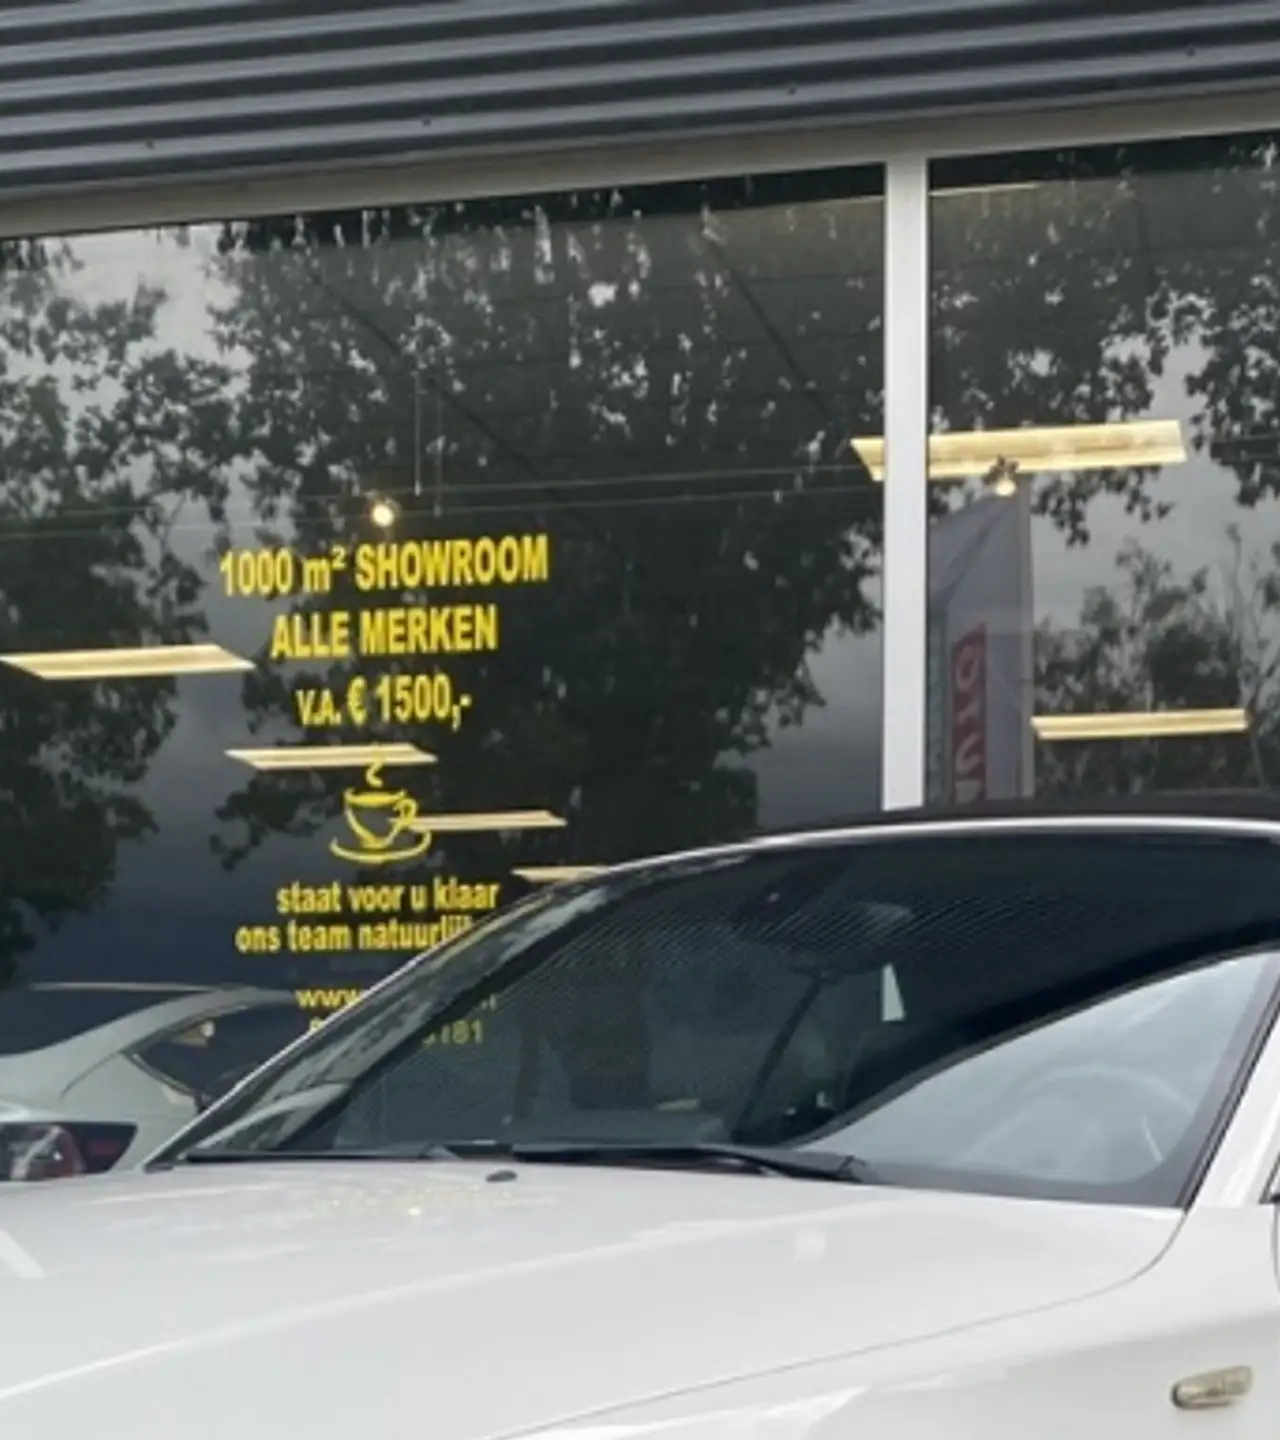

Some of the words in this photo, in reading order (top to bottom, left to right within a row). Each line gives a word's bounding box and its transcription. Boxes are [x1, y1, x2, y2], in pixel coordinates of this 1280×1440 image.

[220, 548, 293, 596] 1000
[356, 533, 549, 591] SHOWROOM
[271, 611, 350, 658] ALLE
[360, 603, 498, 655] MERKEN
[347, 675, 368, 725] €
[375, 673, 473, 731] 1500,-
[276, 879, 342, 914] staat
[348, 884, 406, 912] voor
[410, 885, 428, 911] u
[432, 876, 501, 911] klaar
[235, 926, 280, 953] ons
[287, 918, 352, 952] team
